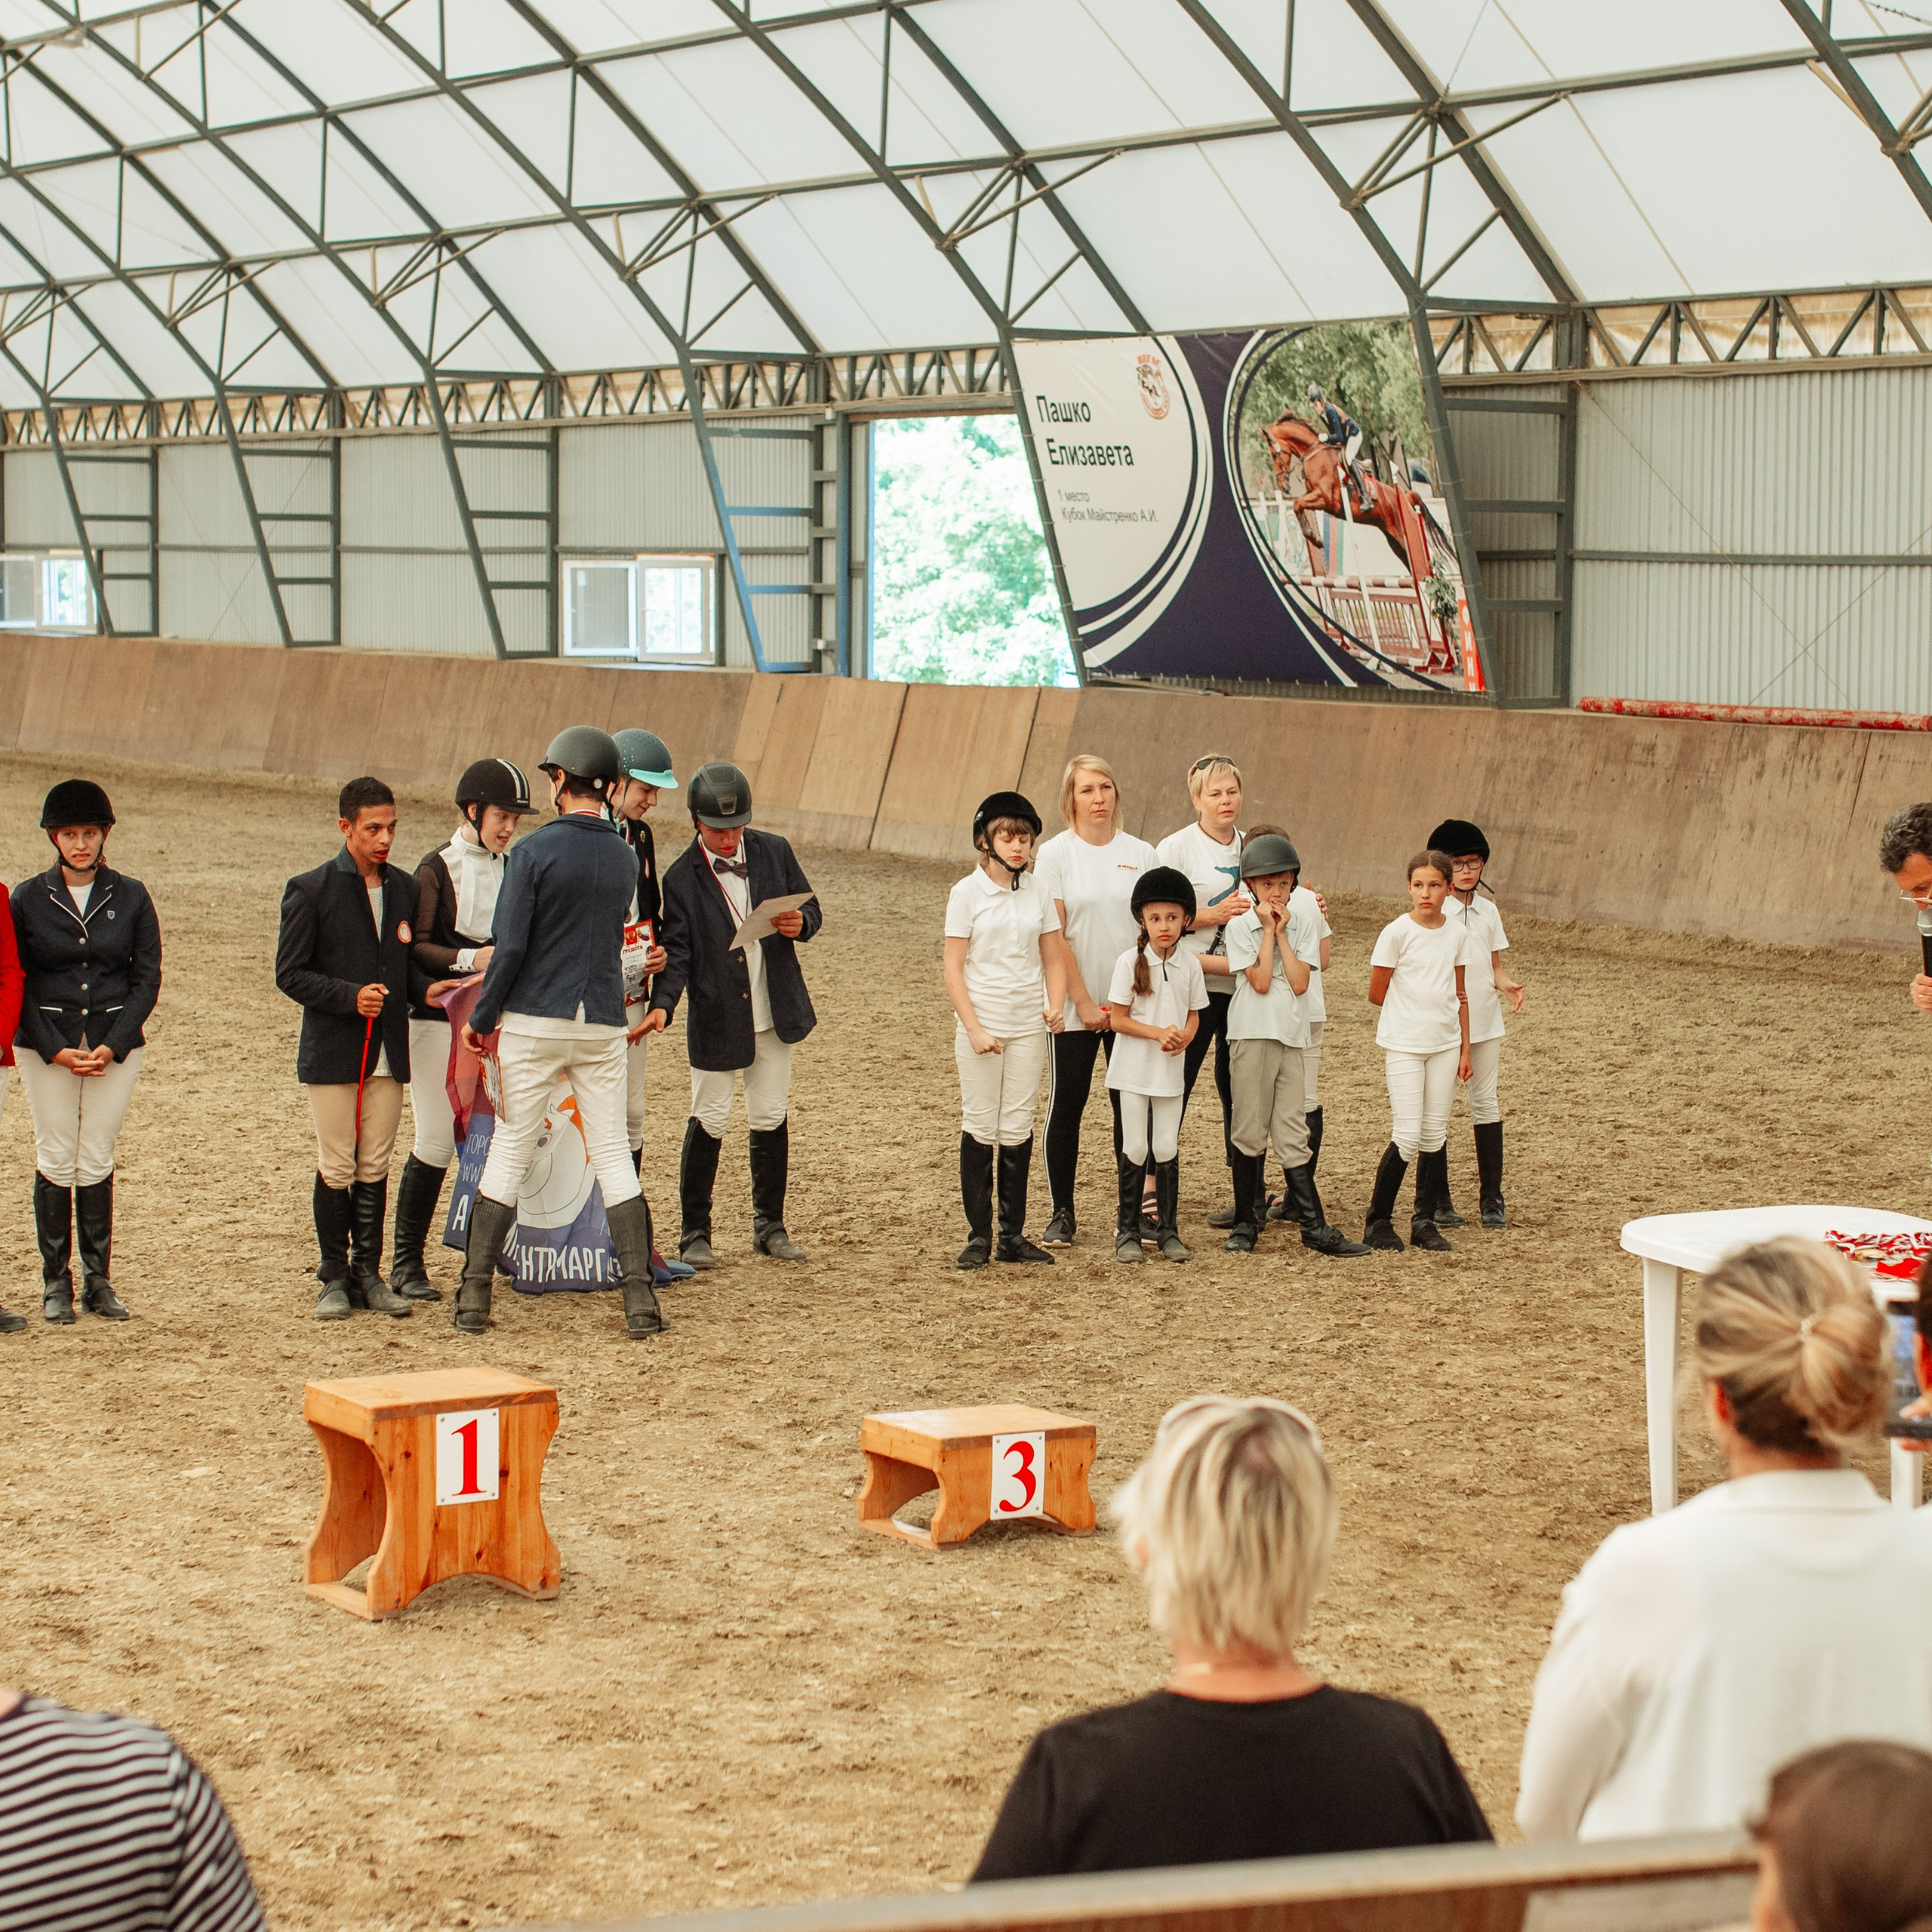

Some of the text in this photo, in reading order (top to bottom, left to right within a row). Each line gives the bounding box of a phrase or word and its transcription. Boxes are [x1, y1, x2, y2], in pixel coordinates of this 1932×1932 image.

[1036, 395, 1091, 423] Пашко
[1046, 438, 1134, 466] Елизавета
[1058, 490, 1090, 503] 1 место
[1061, 507, 1160, 525] Кубок Майстренко А.И.
[451, 1418, 488, 1497] 1
[999, 1441, 1036, 1512] 3
